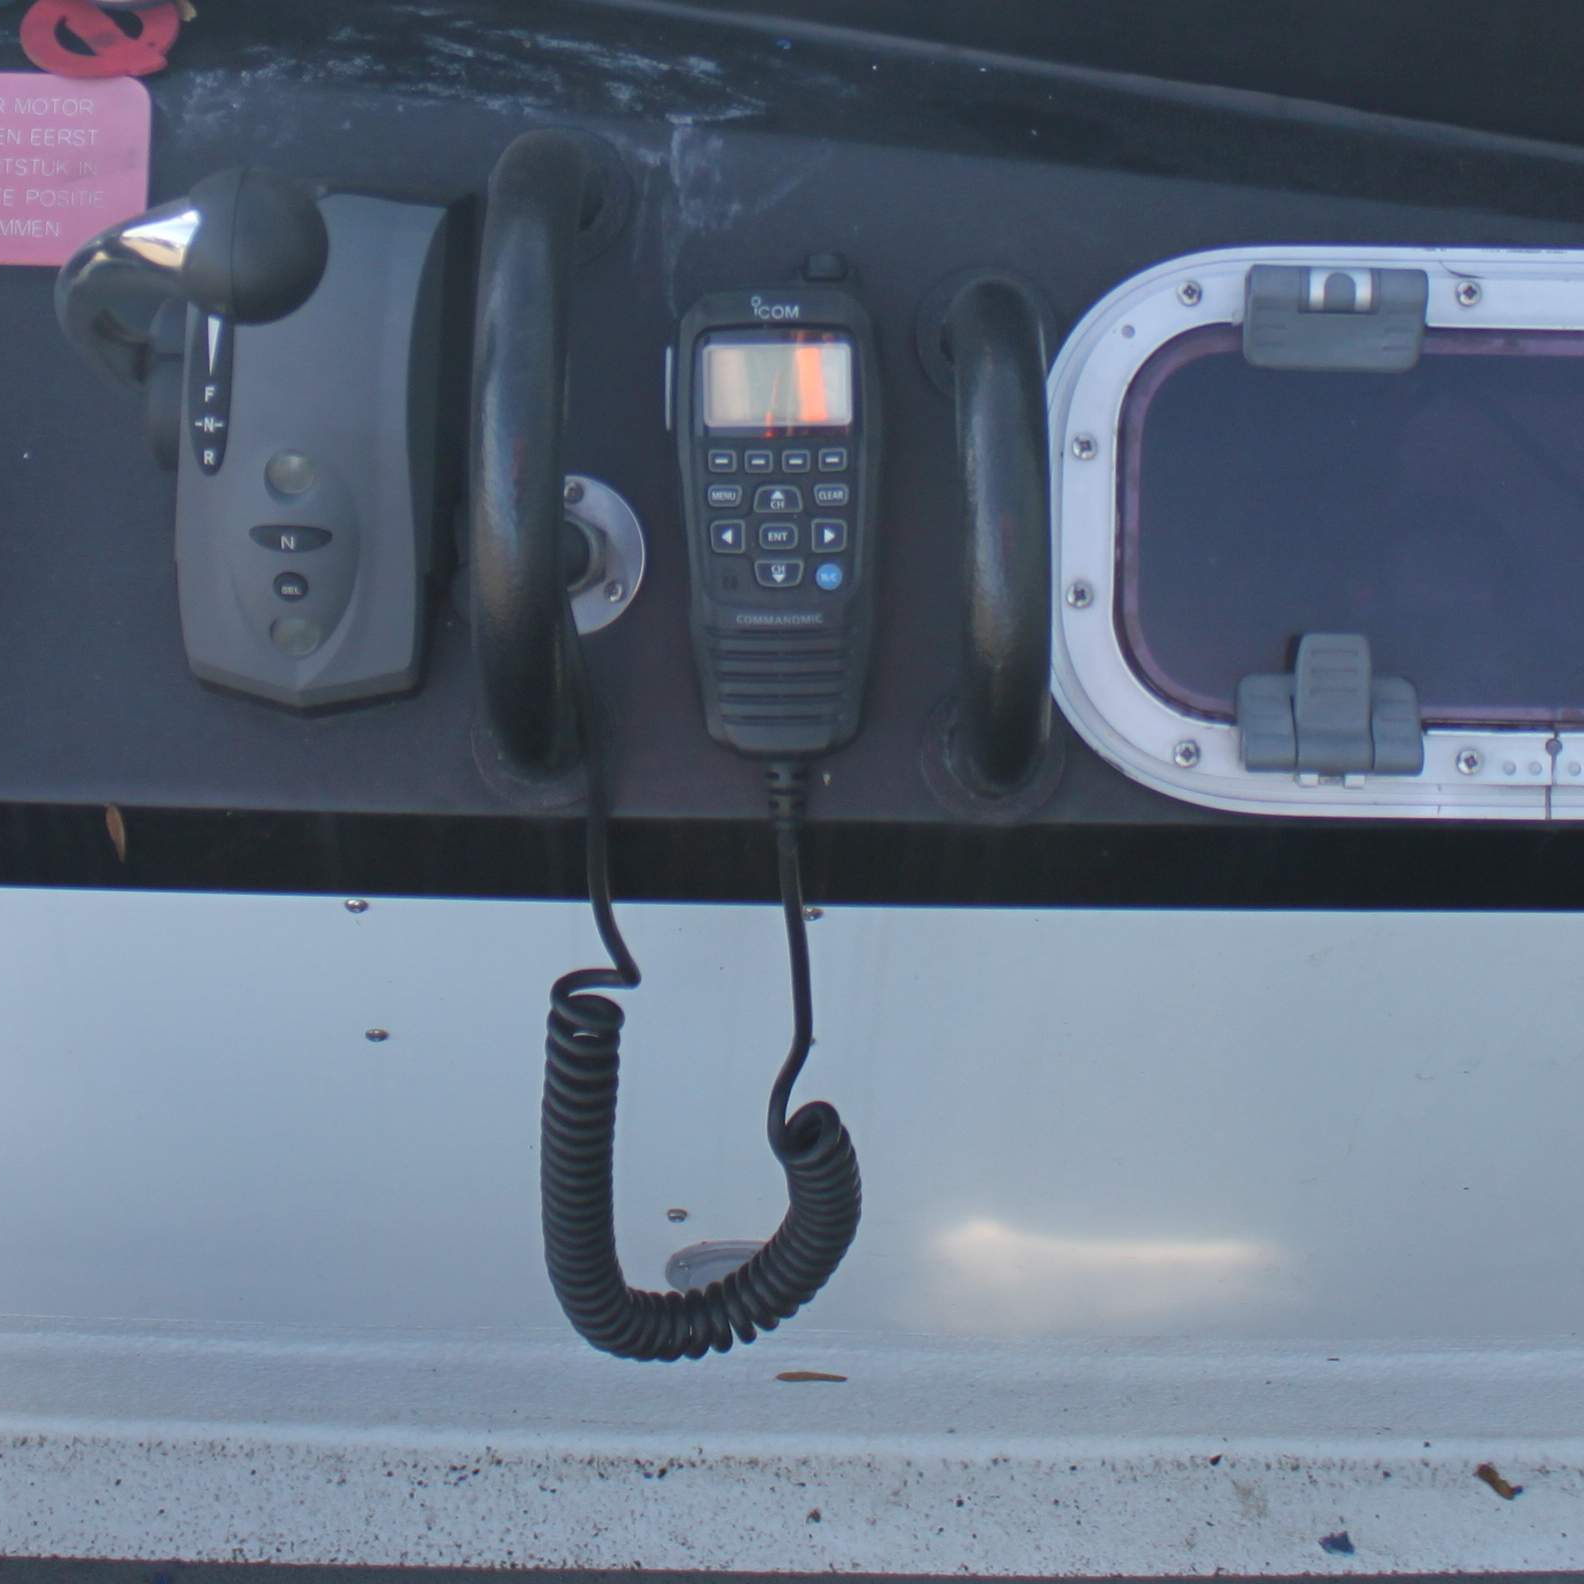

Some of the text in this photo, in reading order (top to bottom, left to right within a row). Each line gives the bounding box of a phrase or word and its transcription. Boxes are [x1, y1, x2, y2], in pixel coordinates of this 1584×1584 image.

[15, 97, 95, 116] MOTOR
[30, 128, 99, 146] EERST
[78, 158, 97, 176] IN
[25, 189, 105, 208] POSITIE
[204, 386, 215, 402] F
[204, 450, 214, 465] R
[710, 489, 737, 501] MENU
[816, 489, 844, 500] CLEAR
[769, 498, 785, 510] CH
[280, 535, 295, 550] N
[767, 530, 788, 542] ENT
[771, 563, 787, 574] CH
